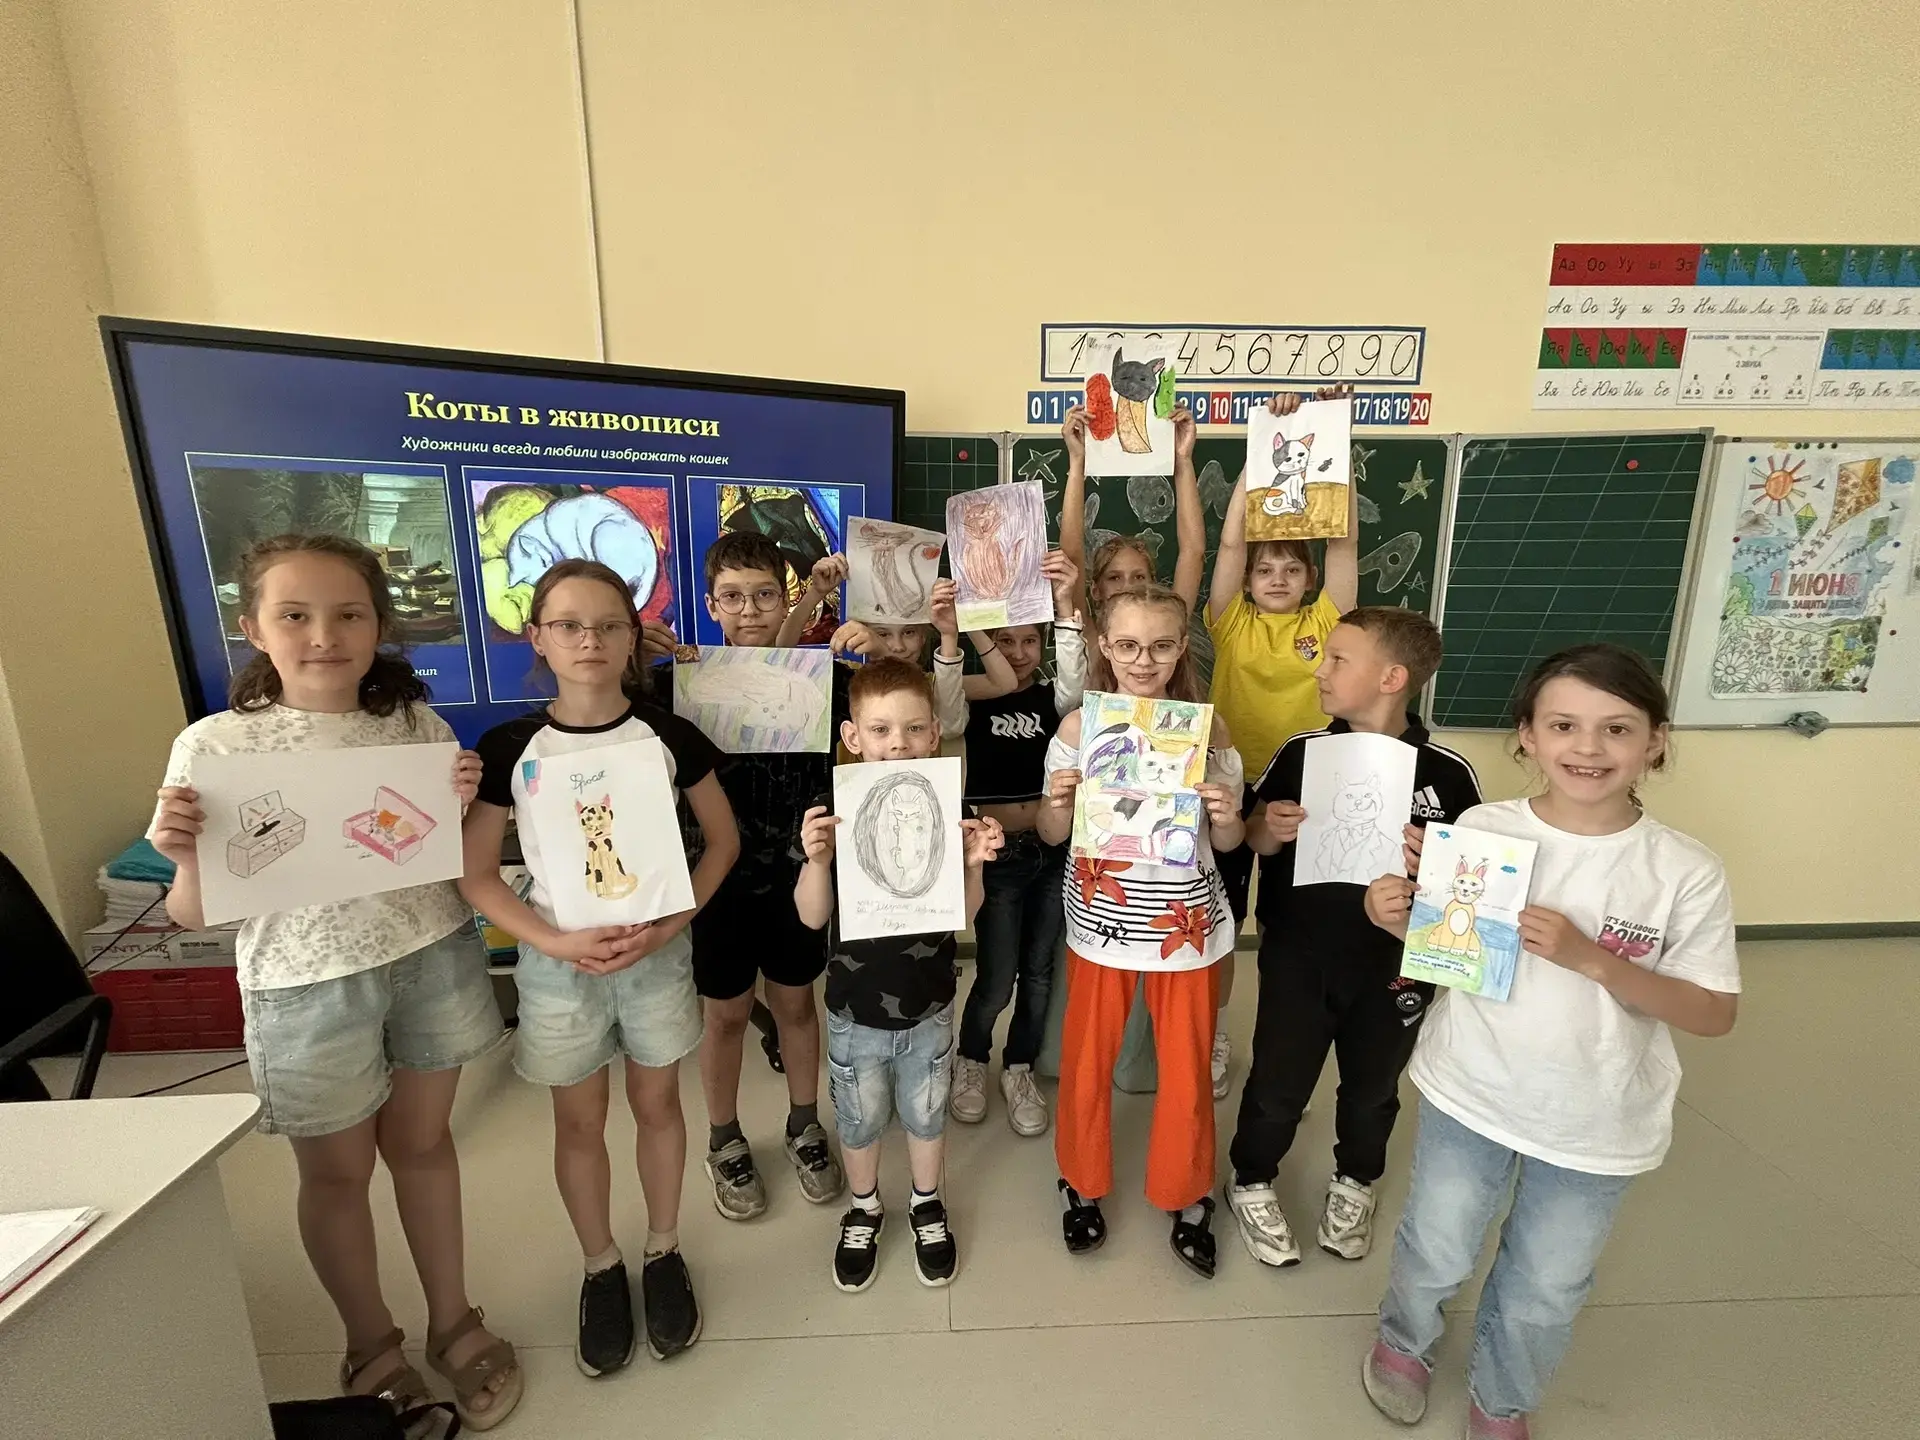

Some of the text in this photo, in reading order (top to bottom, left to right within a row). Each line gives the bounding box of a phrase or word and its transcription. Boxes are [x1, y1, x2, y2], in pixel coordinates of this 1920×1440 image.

[1558, 258, 1576, 271] Аа
[1586, 257, 1606, 271] Оо
[1618, 256, 1634, 273] Уу
[1675, 258, 1693, 271] Ээ
[1548, 297, 1573, 314] Аа
[1580, 297, 1599, 314] Оо
[1609, 297, 1628, 320] Уу
[1641, 303, 1653, 314] ы
[1667, 297, 1685, 313] Ээ
[1693, 297, 1716, 314] Нн
[1068, 332, 1417, 376] 1 4 5 6 7 8 9 0
[1538, 380, 1560, 397] Яя
[1592, 380, 1619, 397] Юю
[1623, 380, 1643, 397] Ии
[404, 391, 721, 438] Коты в живописи
[1031, 396, 1042, 419] 0
[1050, 396, 1059, 419] 1
[1196, 397, 1207, 419] 9
[1212, 397, 1229, 419] 10
[1233, 397, 1249, 419] 11
[1354, 398, 1370, 420] 17
[1373, 398, 1391, 420] 18
[1394, 398, 1410, 420] 19
[1411, 399, 1430, 420] 20
[402, 436, 729, 466] Художники всегда любили изображать кошек
[1767, 568, 1862, 596] 1 ИЮНЯ
[1410, 802, 1446, 818] didas
[1605, 915, 1660, 935] IT'S ALL ABOUT
